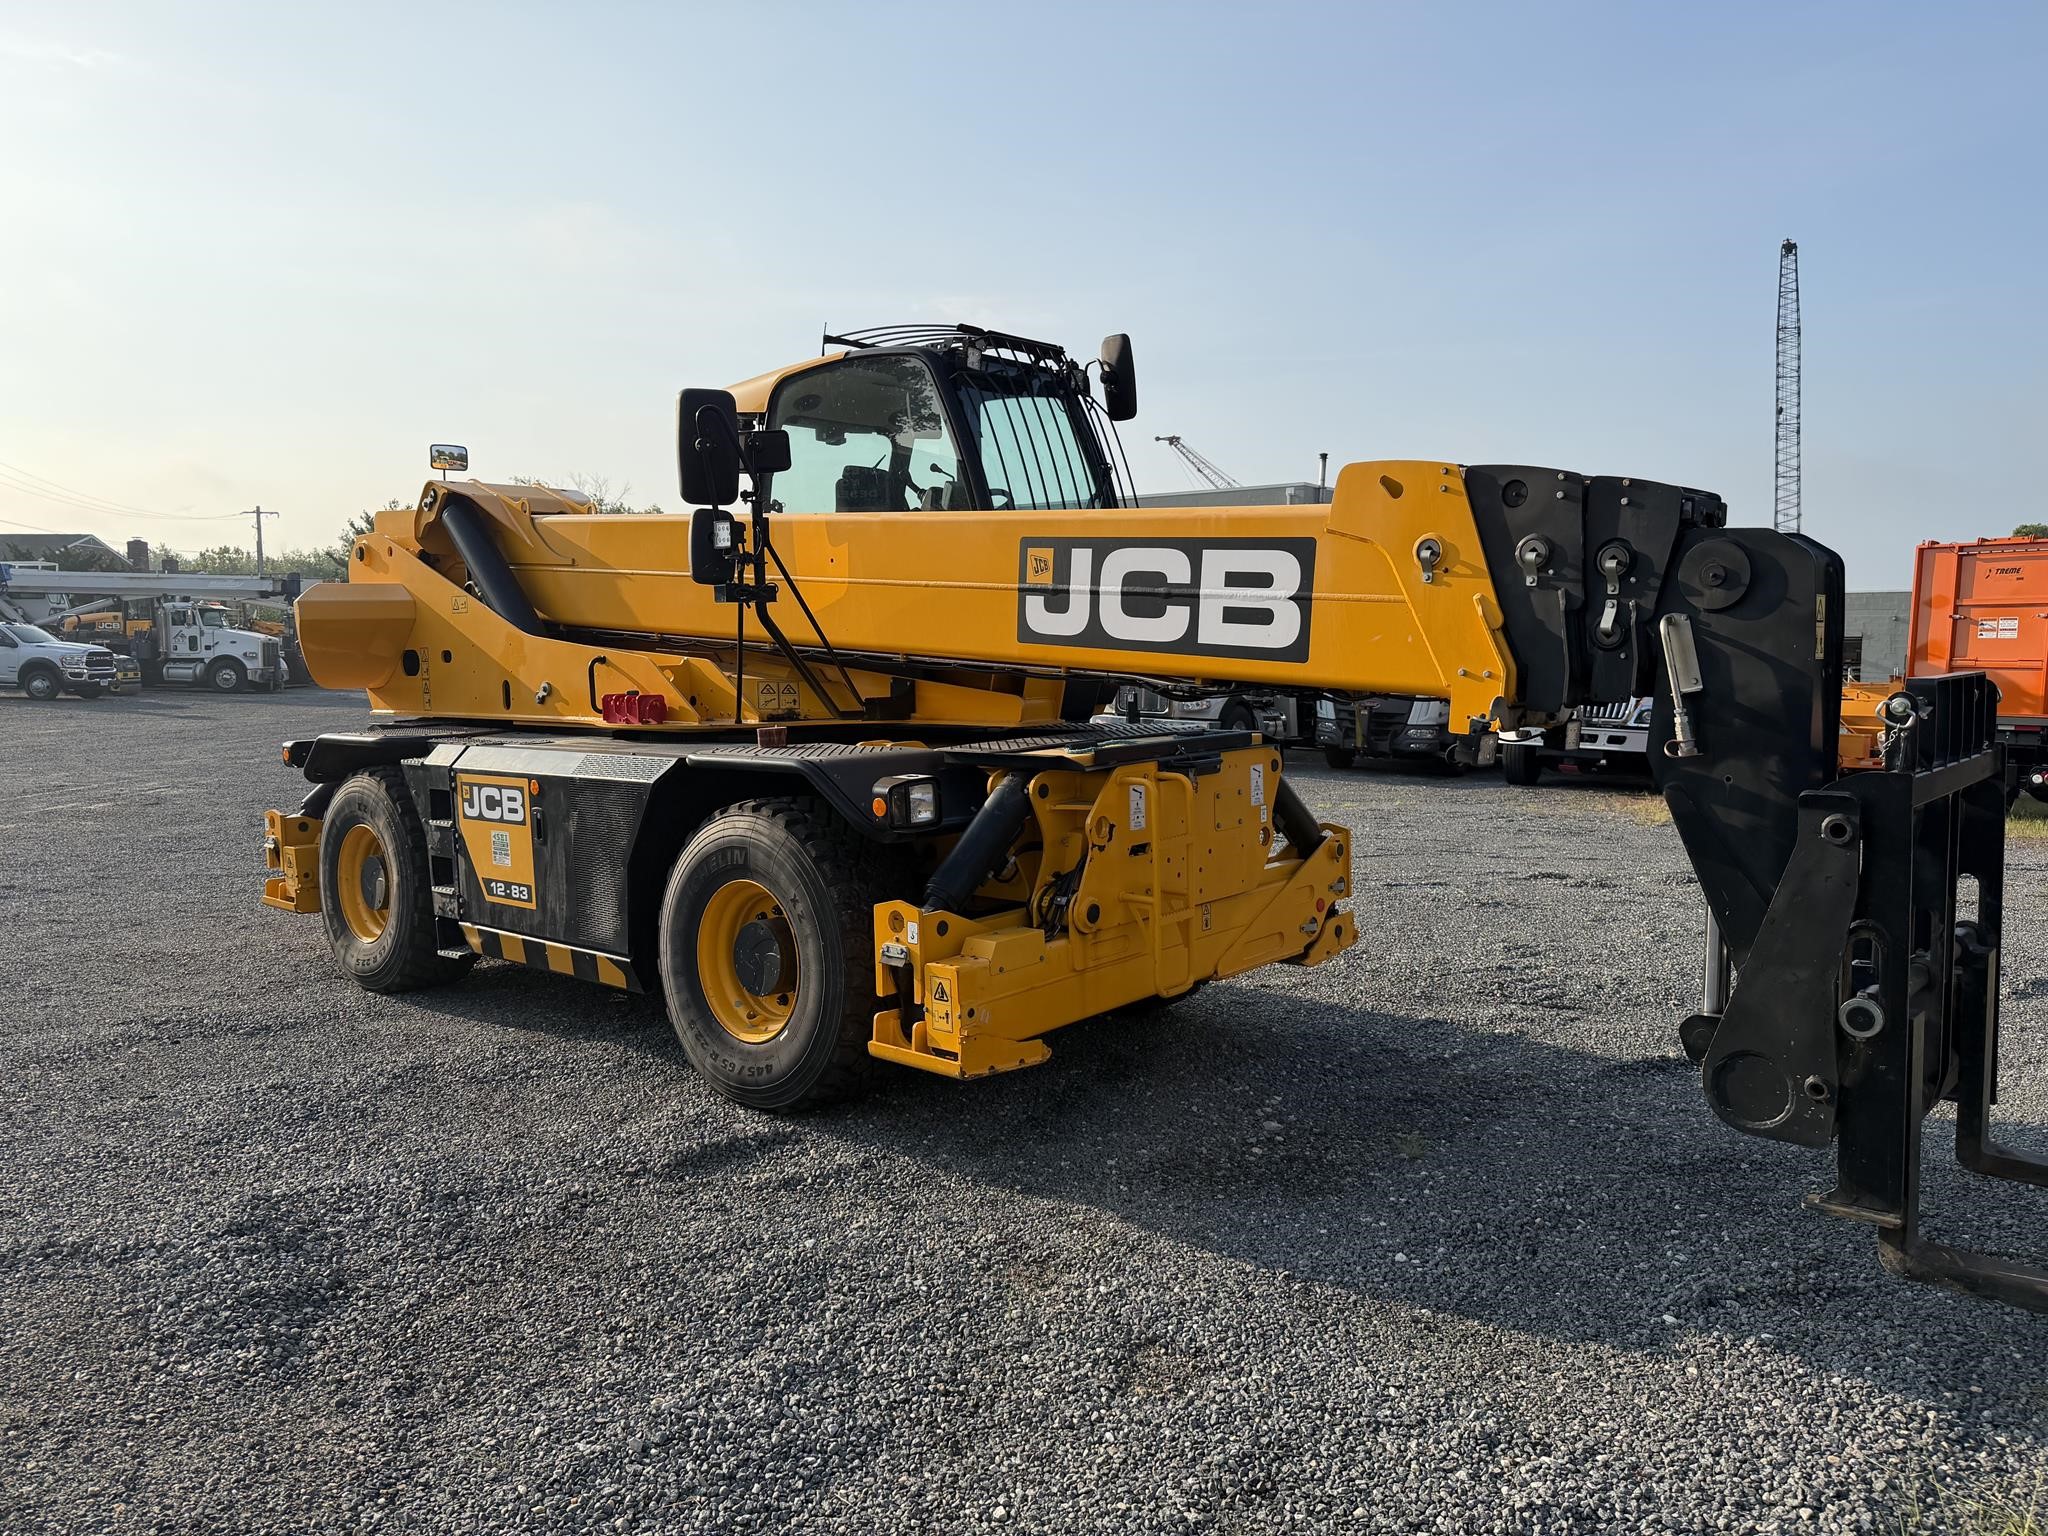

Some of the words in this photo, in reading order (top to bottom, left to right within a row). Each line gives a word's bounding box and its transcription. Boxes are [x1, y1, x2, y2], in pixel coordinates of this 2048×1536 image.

[1033, 557, 1049, 574] JCB
[1025, 547, 1302, 649] JCB
[98, 621, 120, 629] JCB
[463, 785, 525, 822] JCB
[490, 881, 528, 899] 12-83
